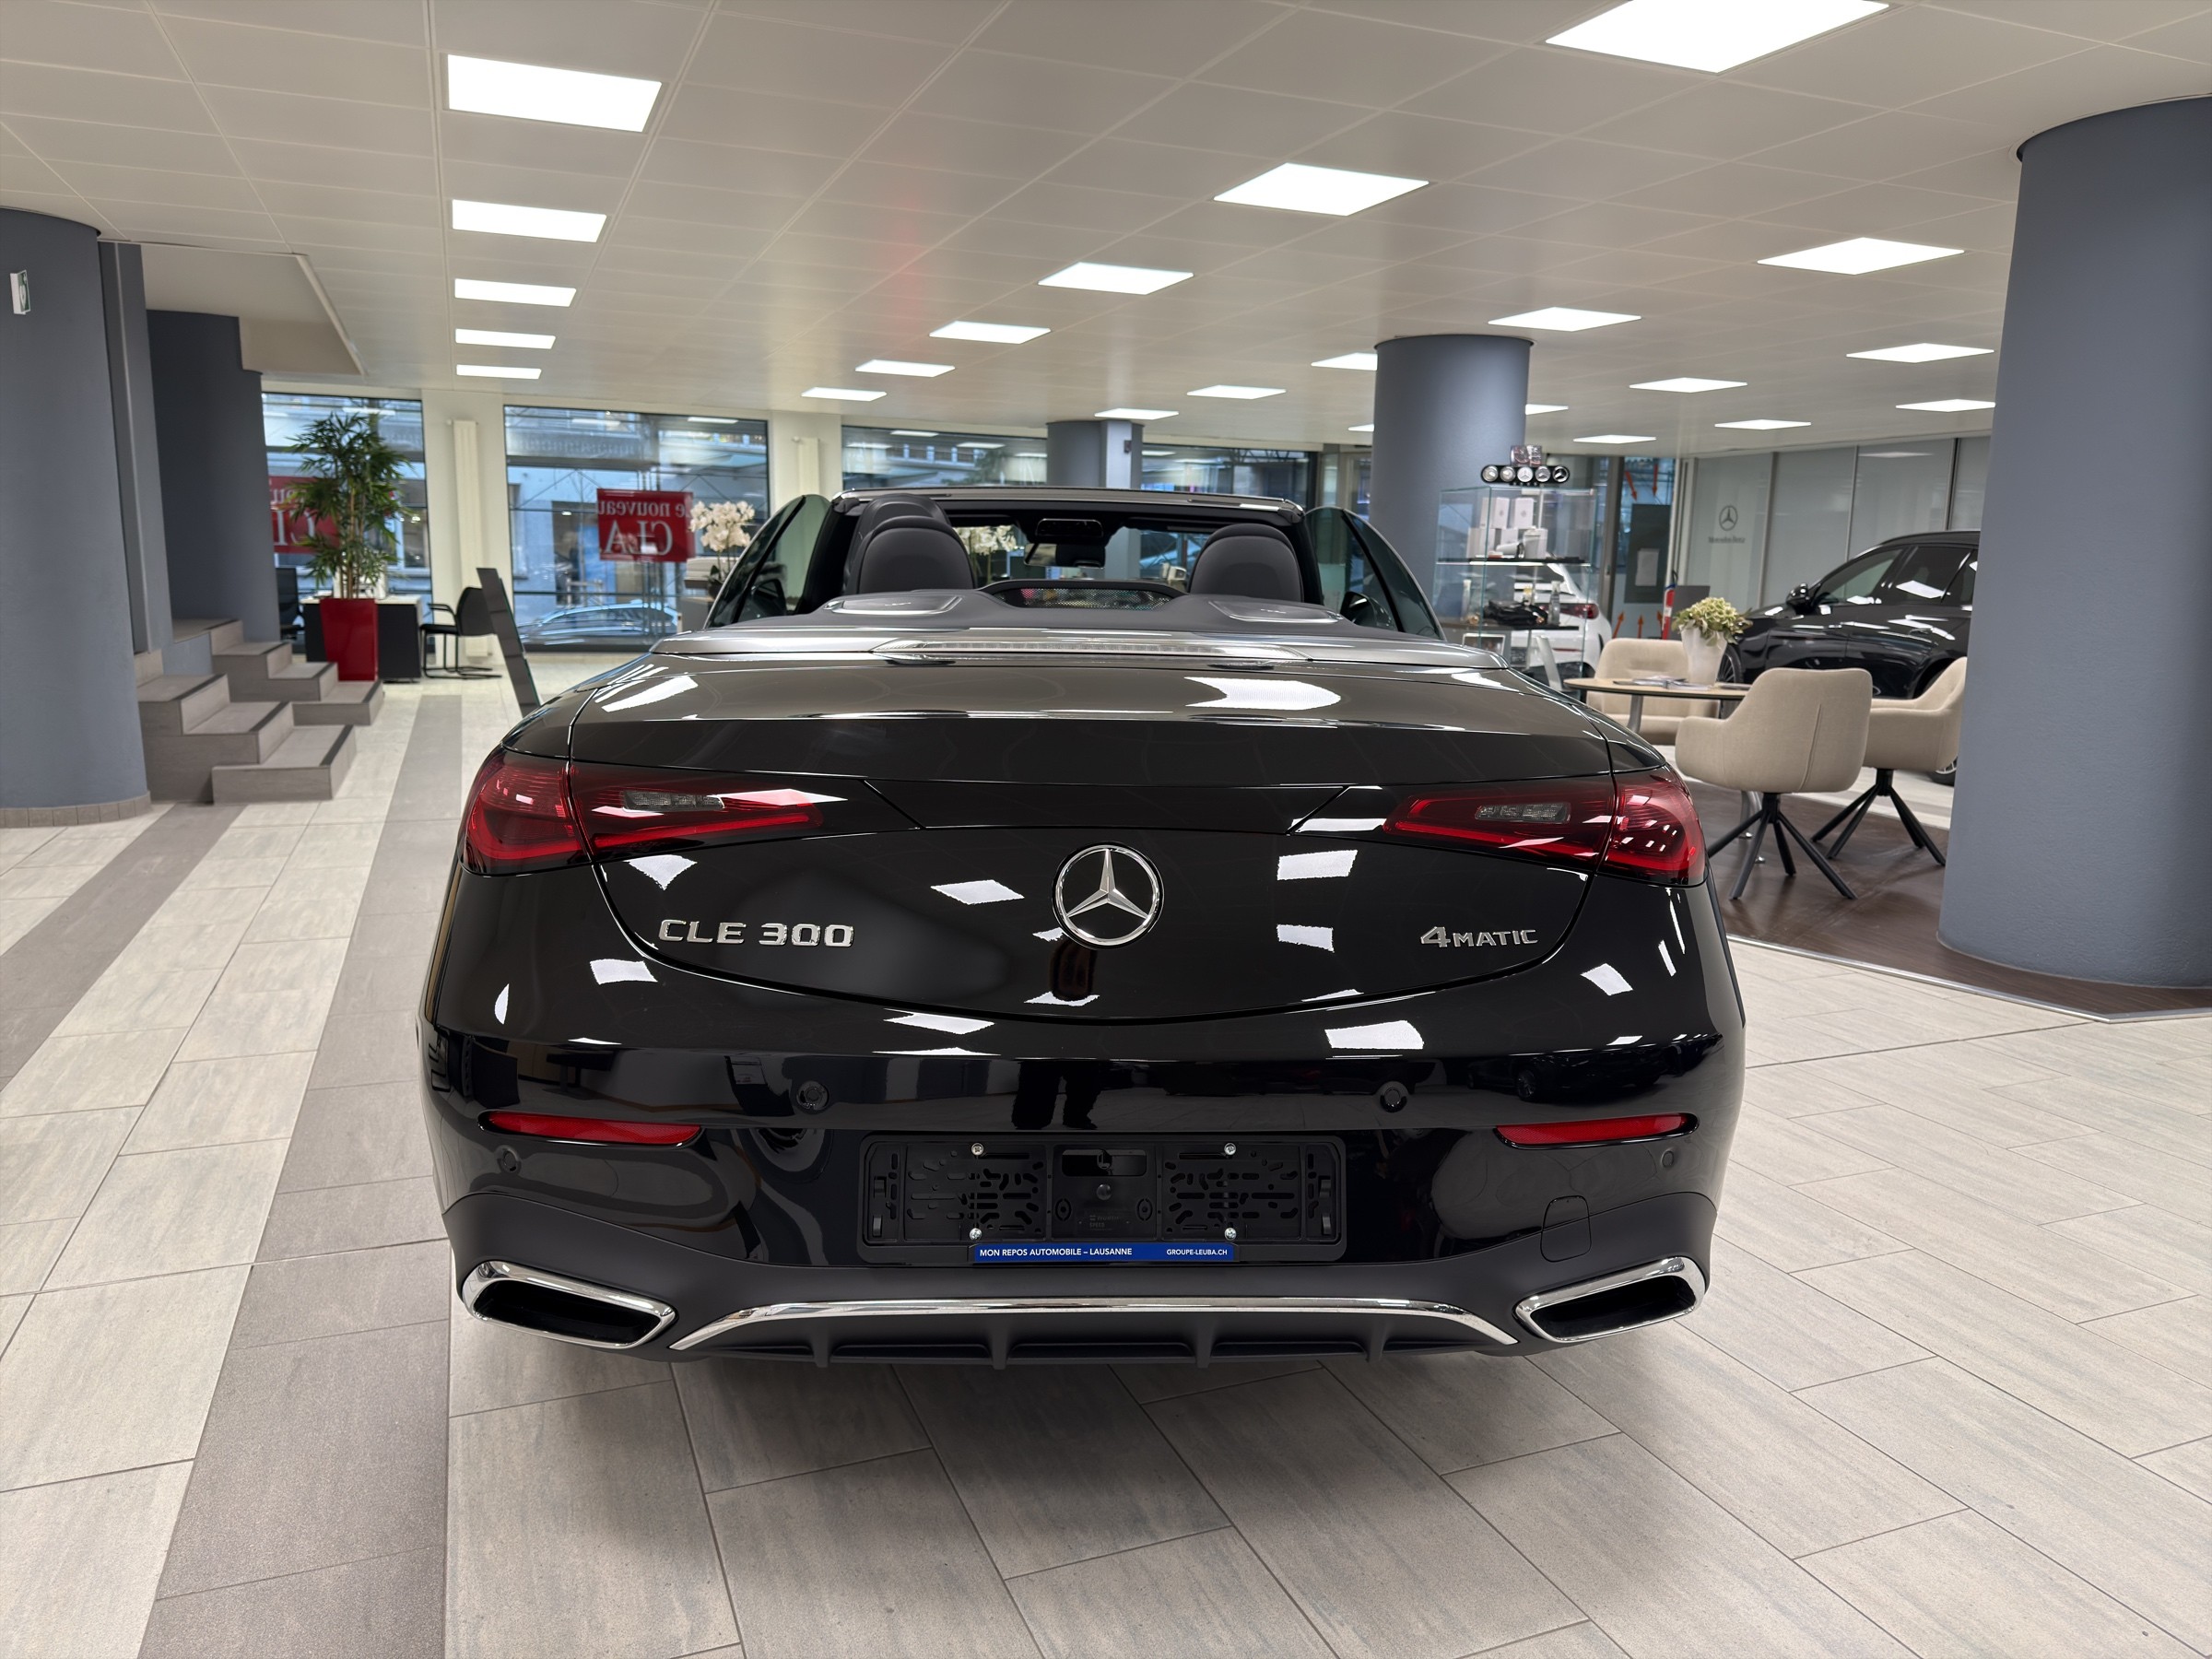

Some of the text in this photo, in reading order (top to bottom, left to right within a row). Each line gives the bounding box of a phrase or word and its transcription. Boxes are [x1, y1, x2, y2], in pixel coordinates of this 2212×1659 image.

[658, 919, 853, 947] CLE 300
[1420, 926, 1538, 948] 4MATIC
[1002, 1248, 1028, 1256] REPOS
[1030, 1248, 1082, 1256] AUTOMOBILE
